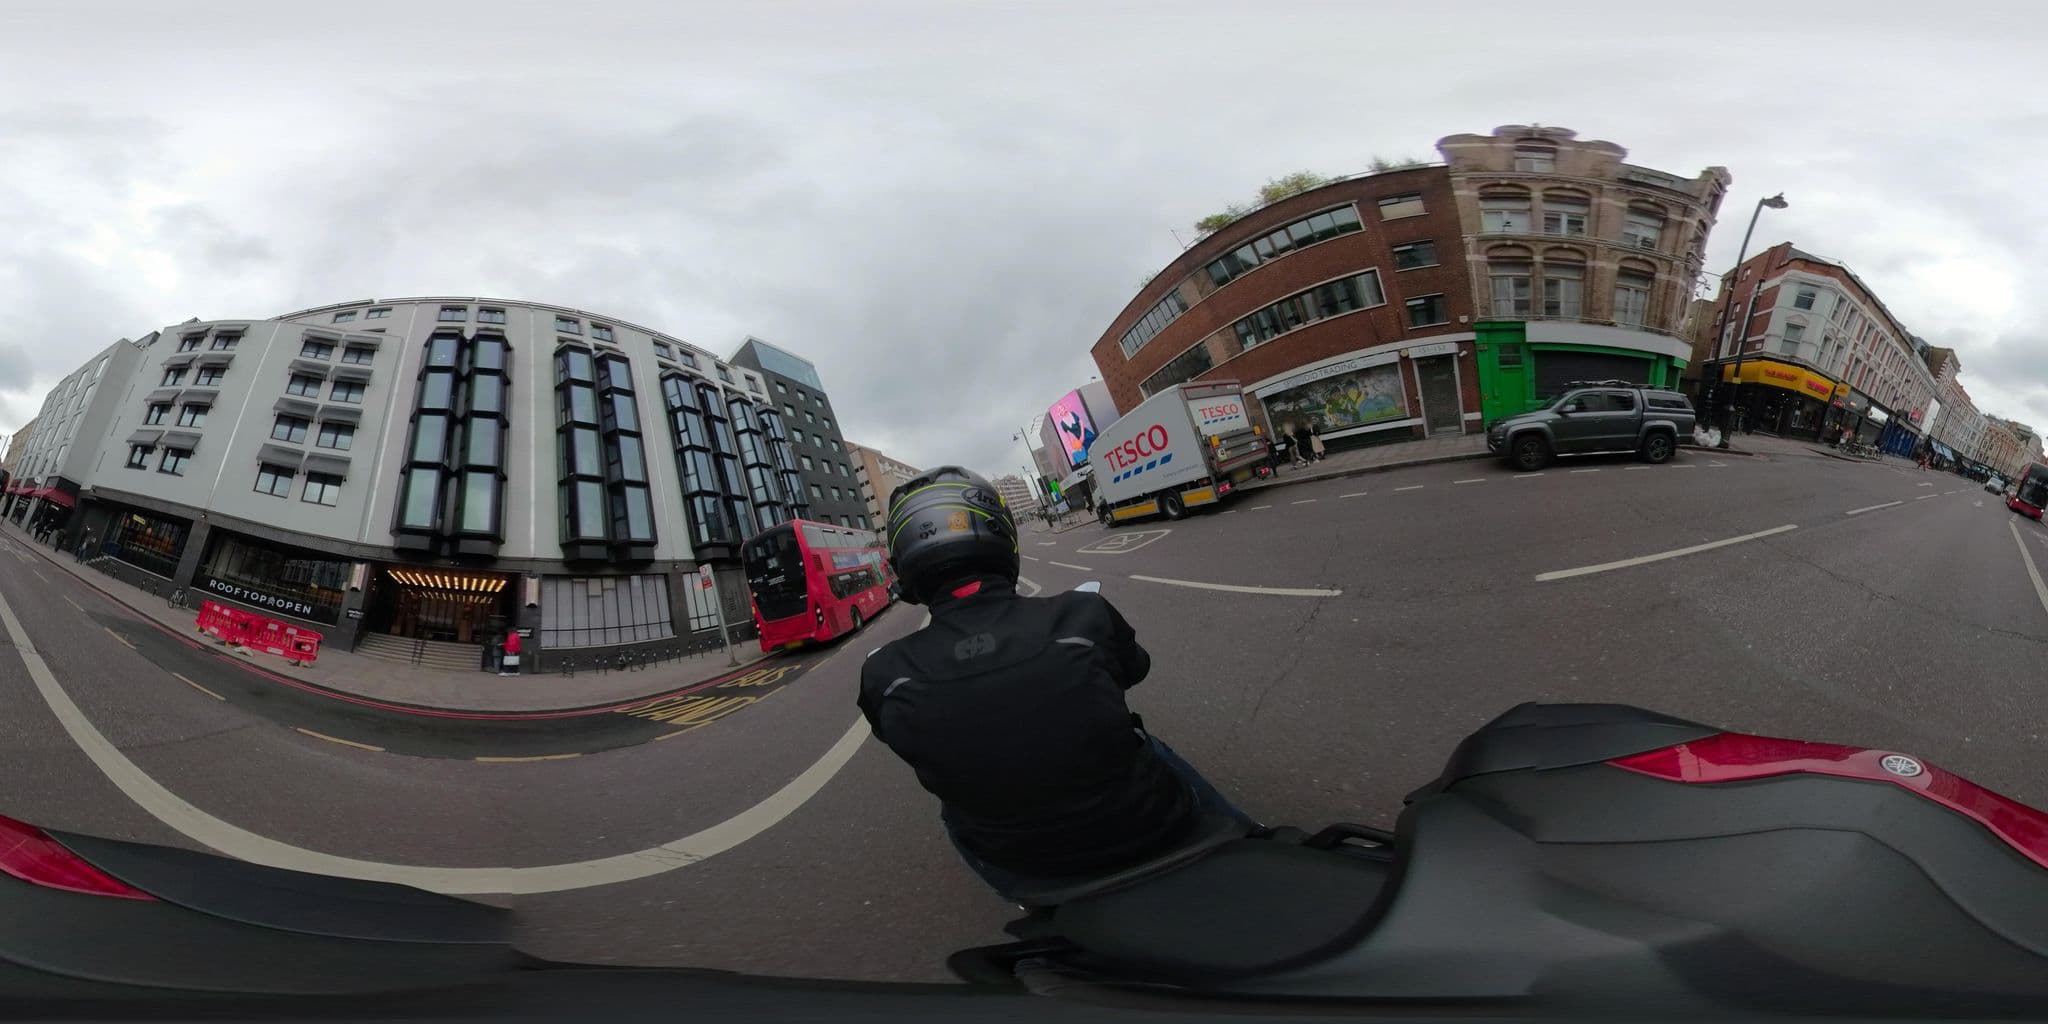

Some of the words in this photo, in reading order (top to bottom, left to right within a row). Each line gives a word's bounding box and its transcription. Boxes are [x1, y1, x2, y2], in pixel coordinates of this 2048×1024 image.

[1318, 361, 1358, 378] TRADING
[1198, 403, 1239, 420] TESCO
[1103, 424, 1169, 473] TESCO
[209, 579, 267, 603] ROOFTOP
[276, 599, 312, 616] OPEN
[716, 664, 802, 688] BUS
